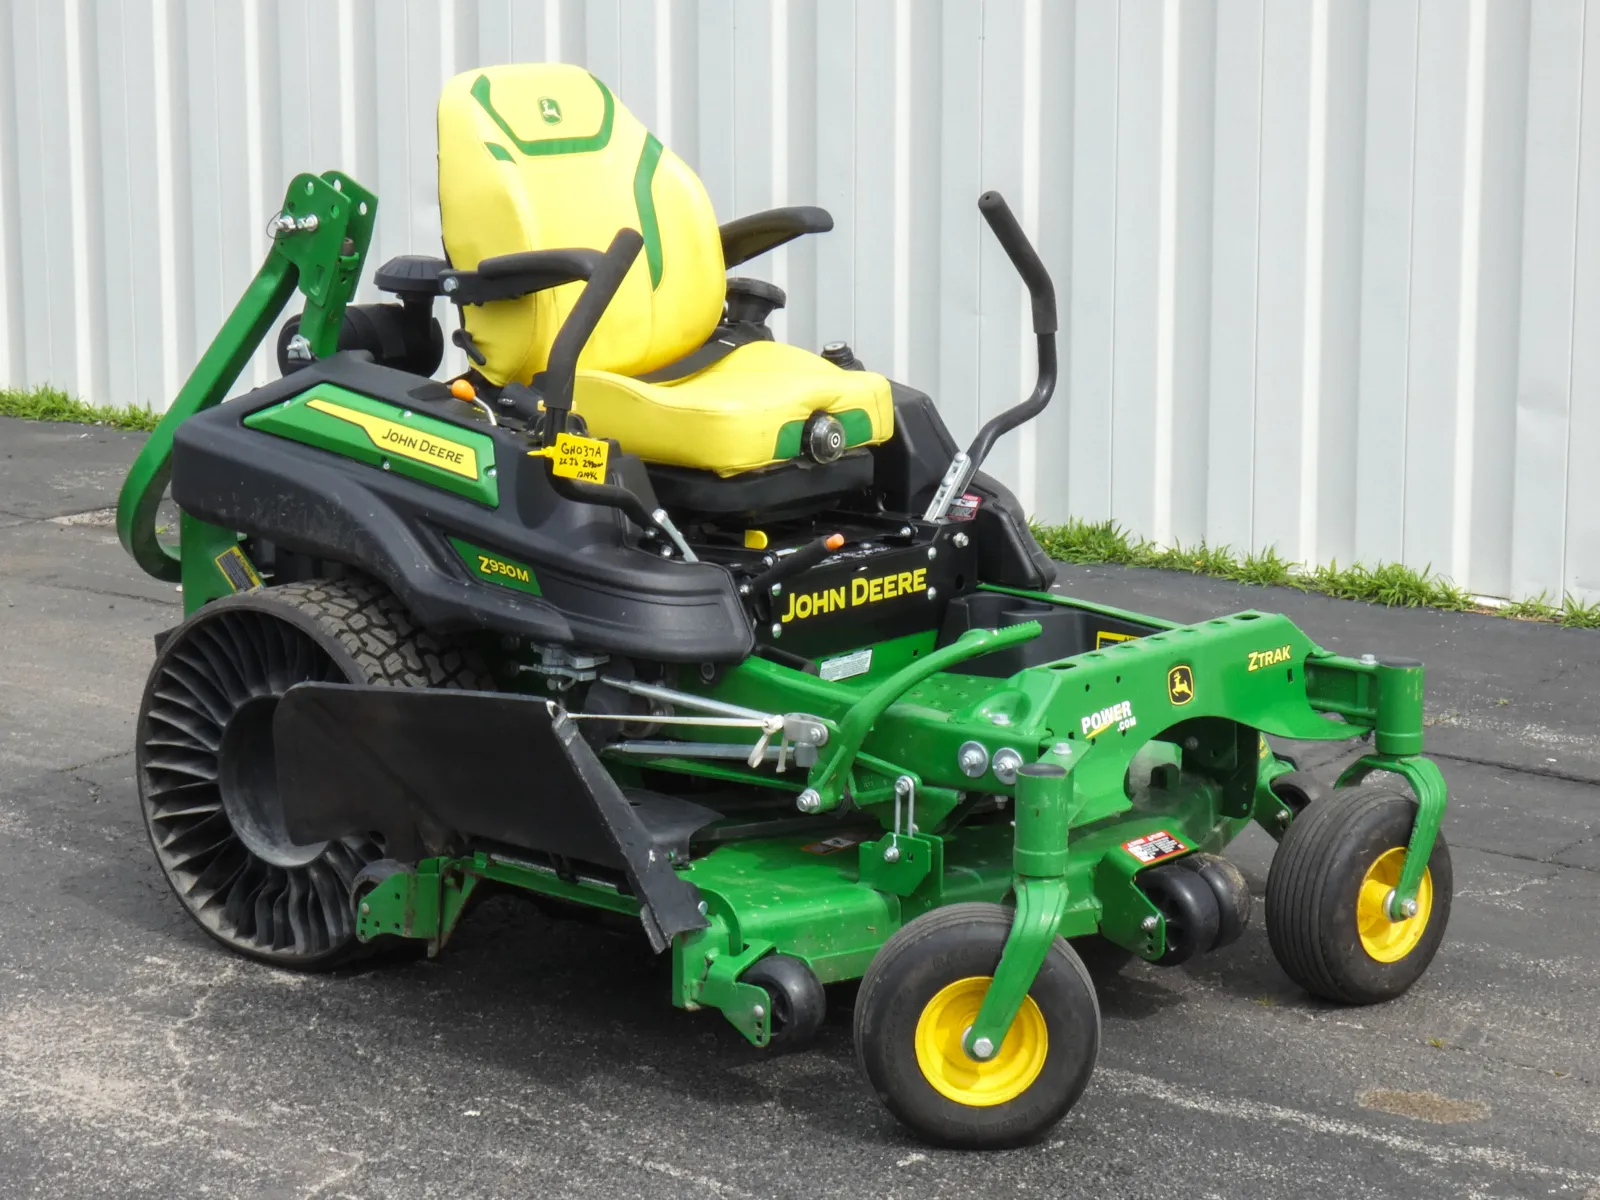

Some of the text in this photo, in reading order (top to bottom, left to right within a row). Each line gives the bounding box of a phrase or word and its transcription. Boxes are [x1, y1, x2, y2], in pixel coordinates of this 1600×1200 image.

[382, 428, 465, 465] JOHN DEERE
[478, 555, 530, 583] Z930M
[781, 567, 927, 623] JOHN DEERE
[1247, 644, 1292, 672] ZTRAK
[1081, 700, 1132, 735] POWER
